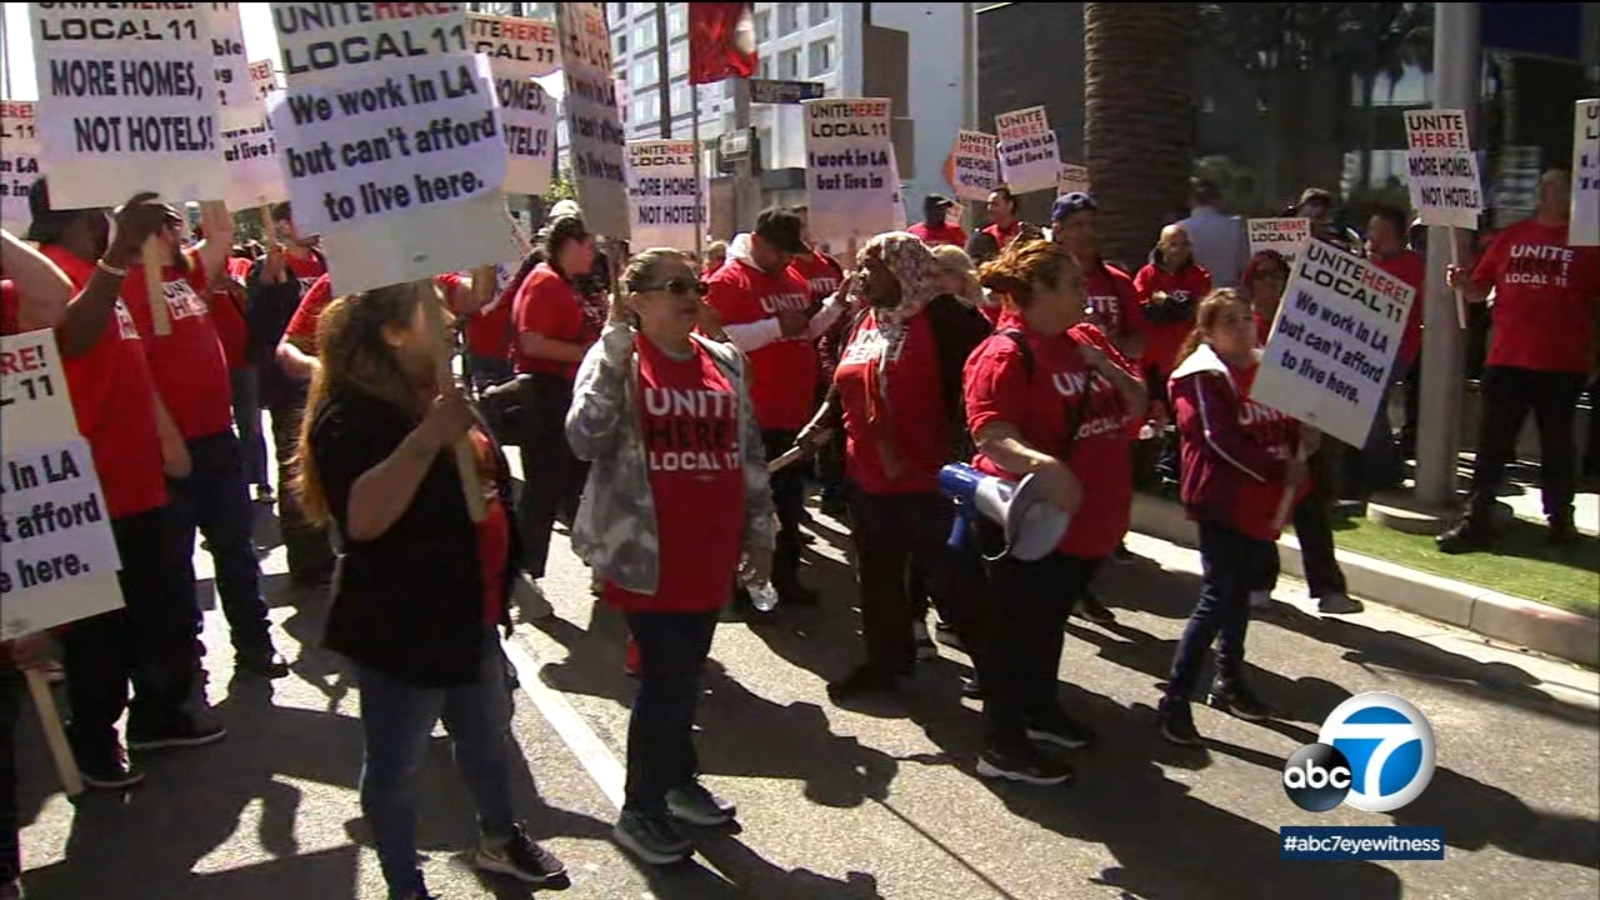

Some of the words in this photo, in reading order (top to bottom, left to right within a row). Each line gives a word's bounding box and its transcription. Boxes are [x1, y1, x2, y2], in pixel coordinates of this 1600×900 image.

[40, 19, 163, 40] LOCAL
[168, 19, 198, 40] 11
[284, 29, 427, 75] LOCAL
[430, 25, 467, 53] 11
[50, 59, 117, 97] MORE
[120, 60, 203, 101] HOMES,
[288, 95, 333, 125] We
[337, 77, 406, 116] work
[409, 74, 437, 104] in
[440, 64, 478, 98] LA
[811, 103, 886, 118] UNITEHERE!
[999, 110, 1042, 128] UNITE
[811, 123, 868, 138] LOCAL
[873, 123, 887, 137] 11
[1001, 121, 1044, 140] HERE!
[1409, 115, 1463, 131] UNITE
[74, 117, 122, 152] NOT
[129, 116, 215, 152] HOTELS!
[286, 142, 337, 178] but
[341, 127, 412, 165] can't
[414, 110, 498, 154] afford
[960, 133, 993, 147] UNITE
[1411, 132, 1465, 149] HERE!
[16, 157, 39, 173] LA
[630, 156, 686, 167] LOCAL
[817, 151, 856, 166] work
[856, 150, 869, 166] in
[871, 150, 889, 166] LA
[1409, 157, 1438, 177] MORE
[816, 174, 841, 190] but
[844, 173, 868, 190] live
[323, 191, 356, 222] to
[359, 182, 412, 216] live
[414, 170, 485, 204] here.
[1421, 186, 1441, 206] NOT
[639, 205, 661, 224] NOT
[1251, 232, 1294, 242] LOCAL
[1510, 244, 1574, 262] UNITE
[1306, 245, 1410, 306] UNITEHERE!
[1505, 272, 1548, 285] LOCAL
[1300, 263, 1381, 312] LOCAL
[1386, 301, 1403, 324] 11
[1295, 291, 1317, 317] We
[1320, 302, 1353, 332] work
[1355, 322, 1371, 344] in
[1372, 331, 1390, 355] LA
[1278, 315, 1305, 343] but
[1304, 331, 1343, 360] can't
[1342, 350, 1385, 384] afford
[1280, 350, 1298, 371] to
[1298, 358, 1324, 384] live
[20, 375, 54, 401] 11
[41, 450, 80, 483] LA
[650, 452, 721, 471] LOCAL
[16, 493, 102, 541] afford
[16, 553, 91, 588] here.
